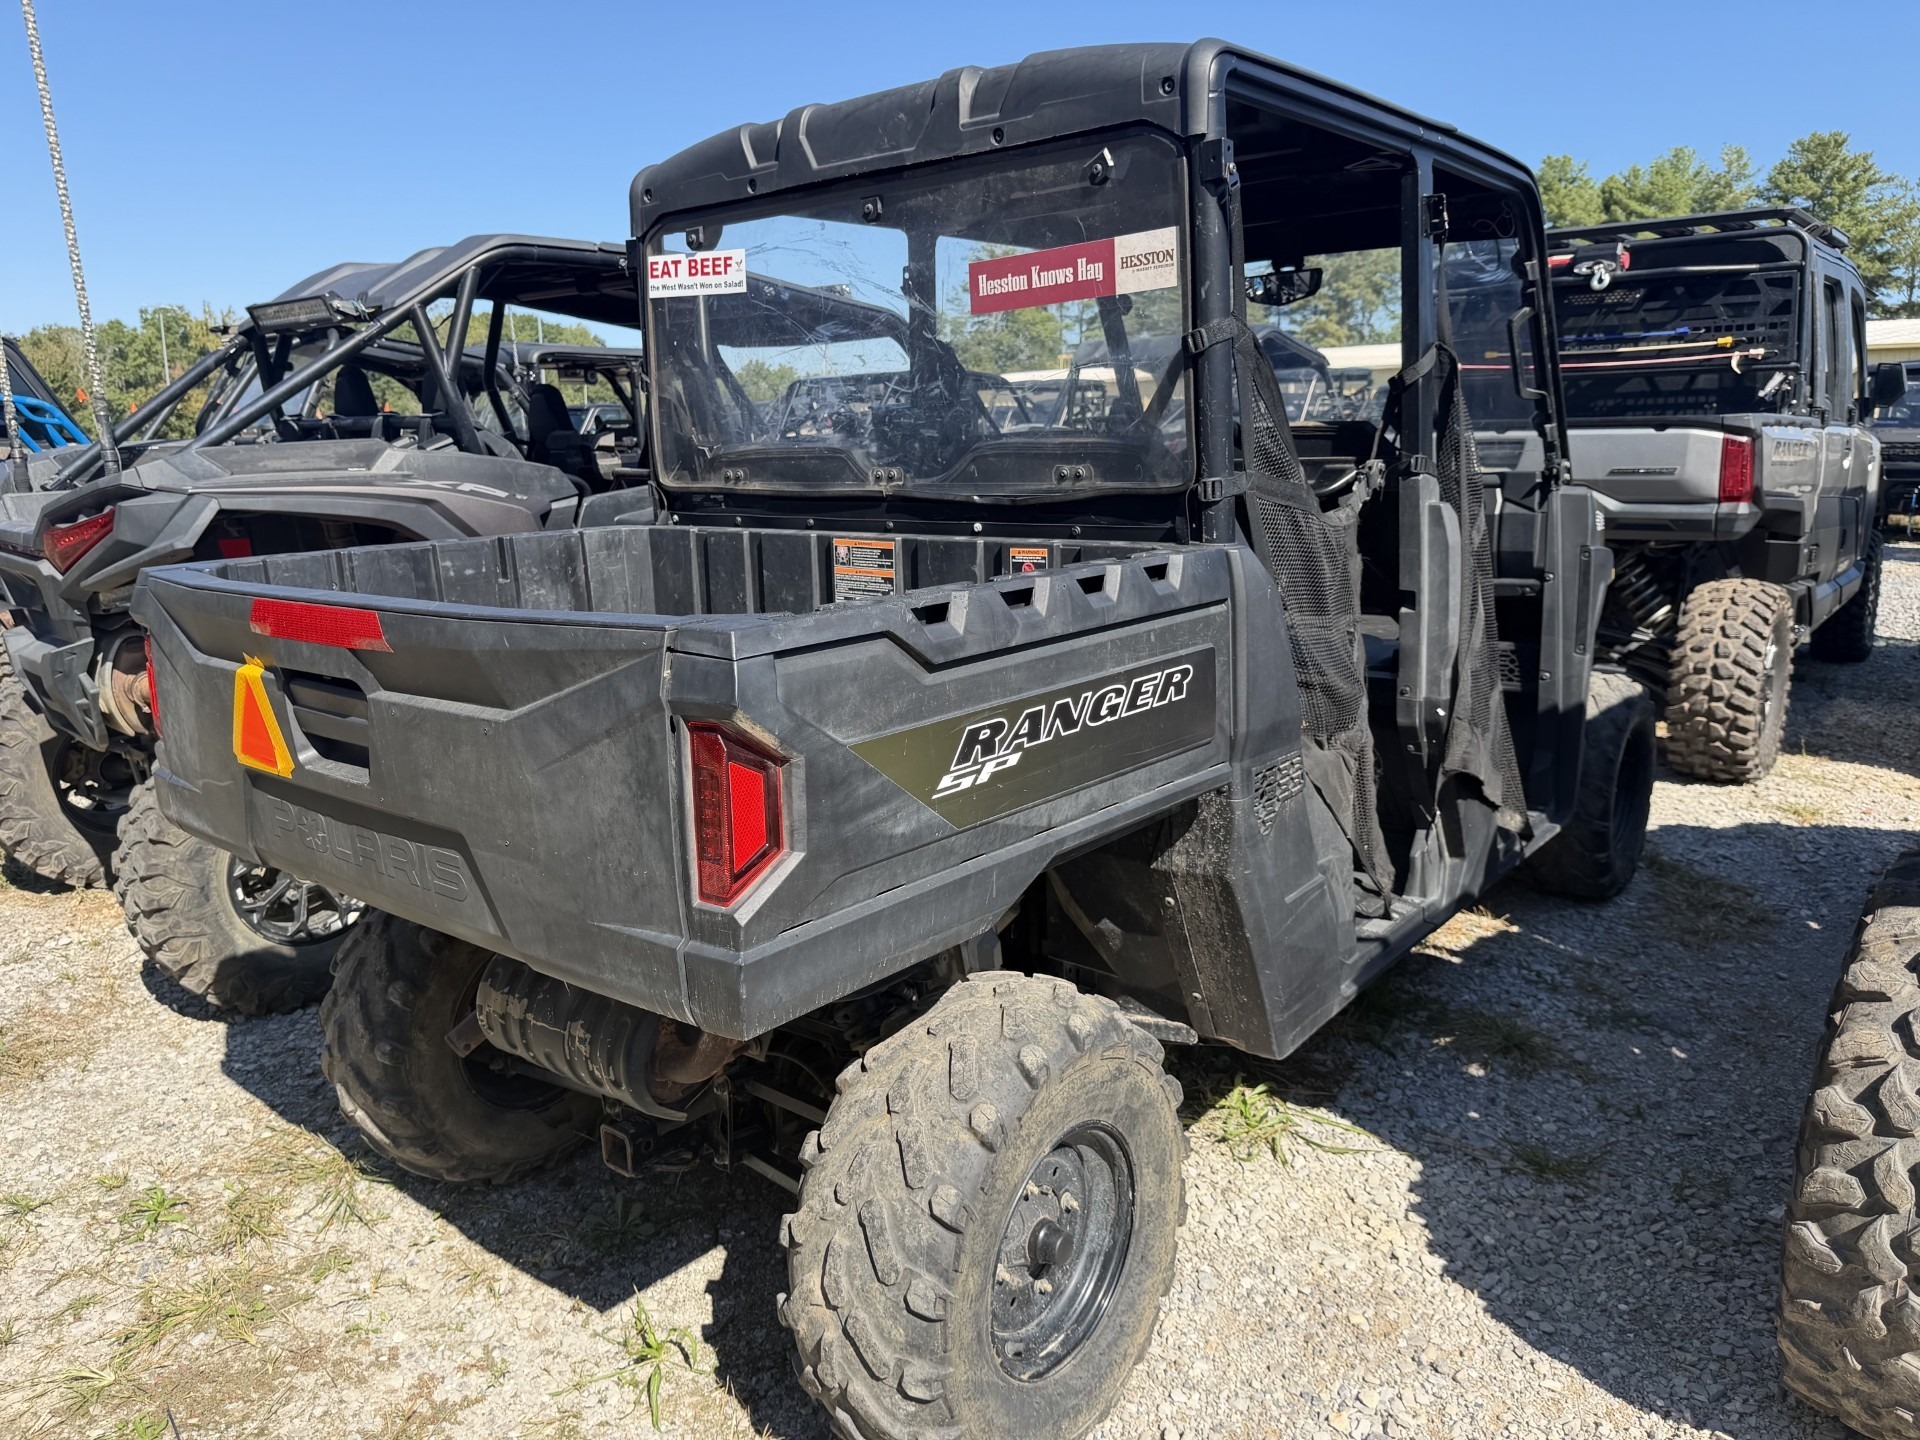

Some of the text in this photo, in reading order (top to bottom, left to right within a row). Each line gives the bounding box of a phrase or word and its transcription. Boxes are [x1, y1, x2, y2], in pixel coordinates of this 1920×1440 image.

[650, 256, 733, 279] EAT BEEF
[978, 257, 1104, 297] Hesston Knows Hay
[1120, 248, 1175, 270] HESSTON
[650, 284, 660, 292] the
[661, 283, 677, 291] West
[678, 282, 698, 290] Wasn't
[700, 281, 713, 290] Won
[714, 281, 723, 289] on
[950, 664, 1193, 771] RANGER
[931, 751, 1023, 800] SP
[266, 795, 468, 902] POLARIS
